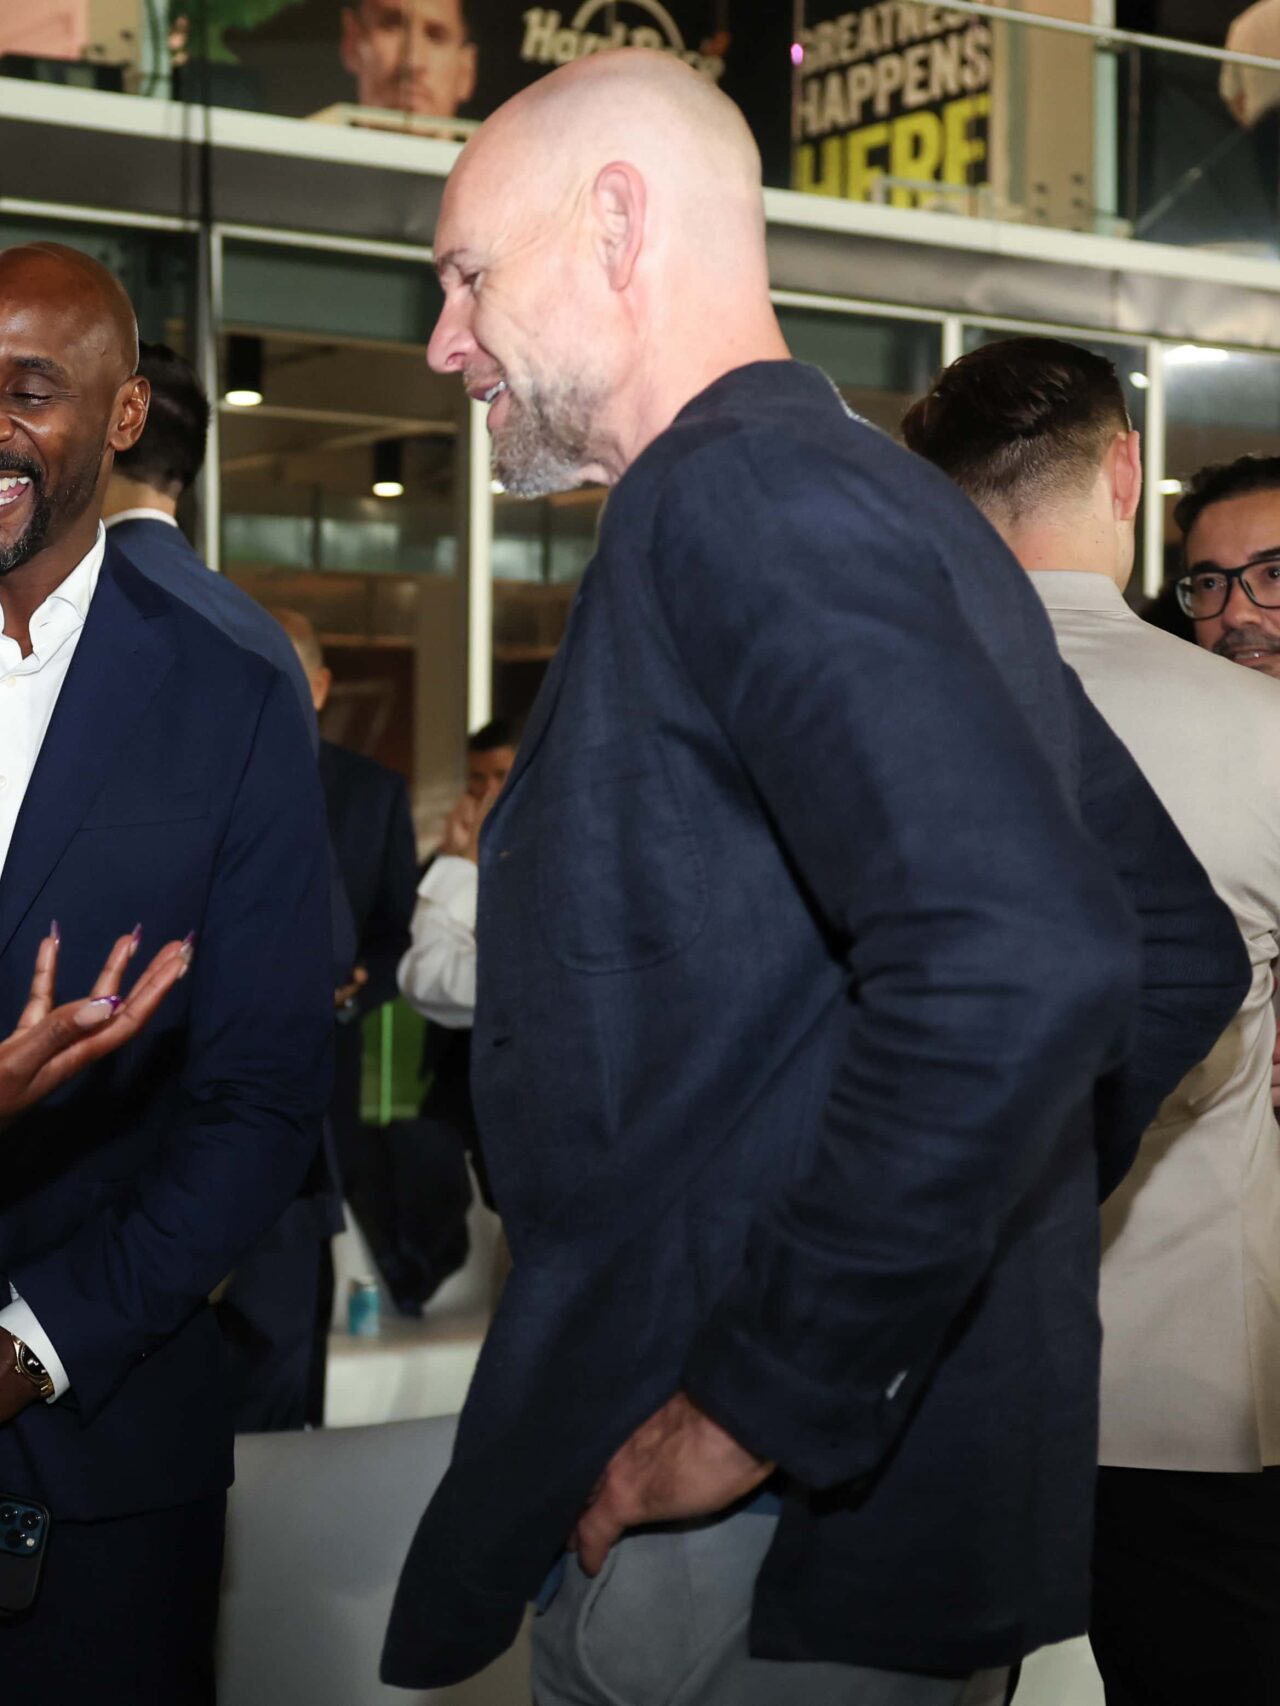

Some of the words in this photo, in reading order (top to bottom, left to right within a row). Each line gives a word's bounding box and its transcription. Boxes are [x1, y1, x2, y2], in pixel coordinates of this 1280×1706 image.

[796, 24, 992, 138] HAPPENS
[797, 0, 978, 76] GREATNE
[792, 92, 992, 208] HERE
